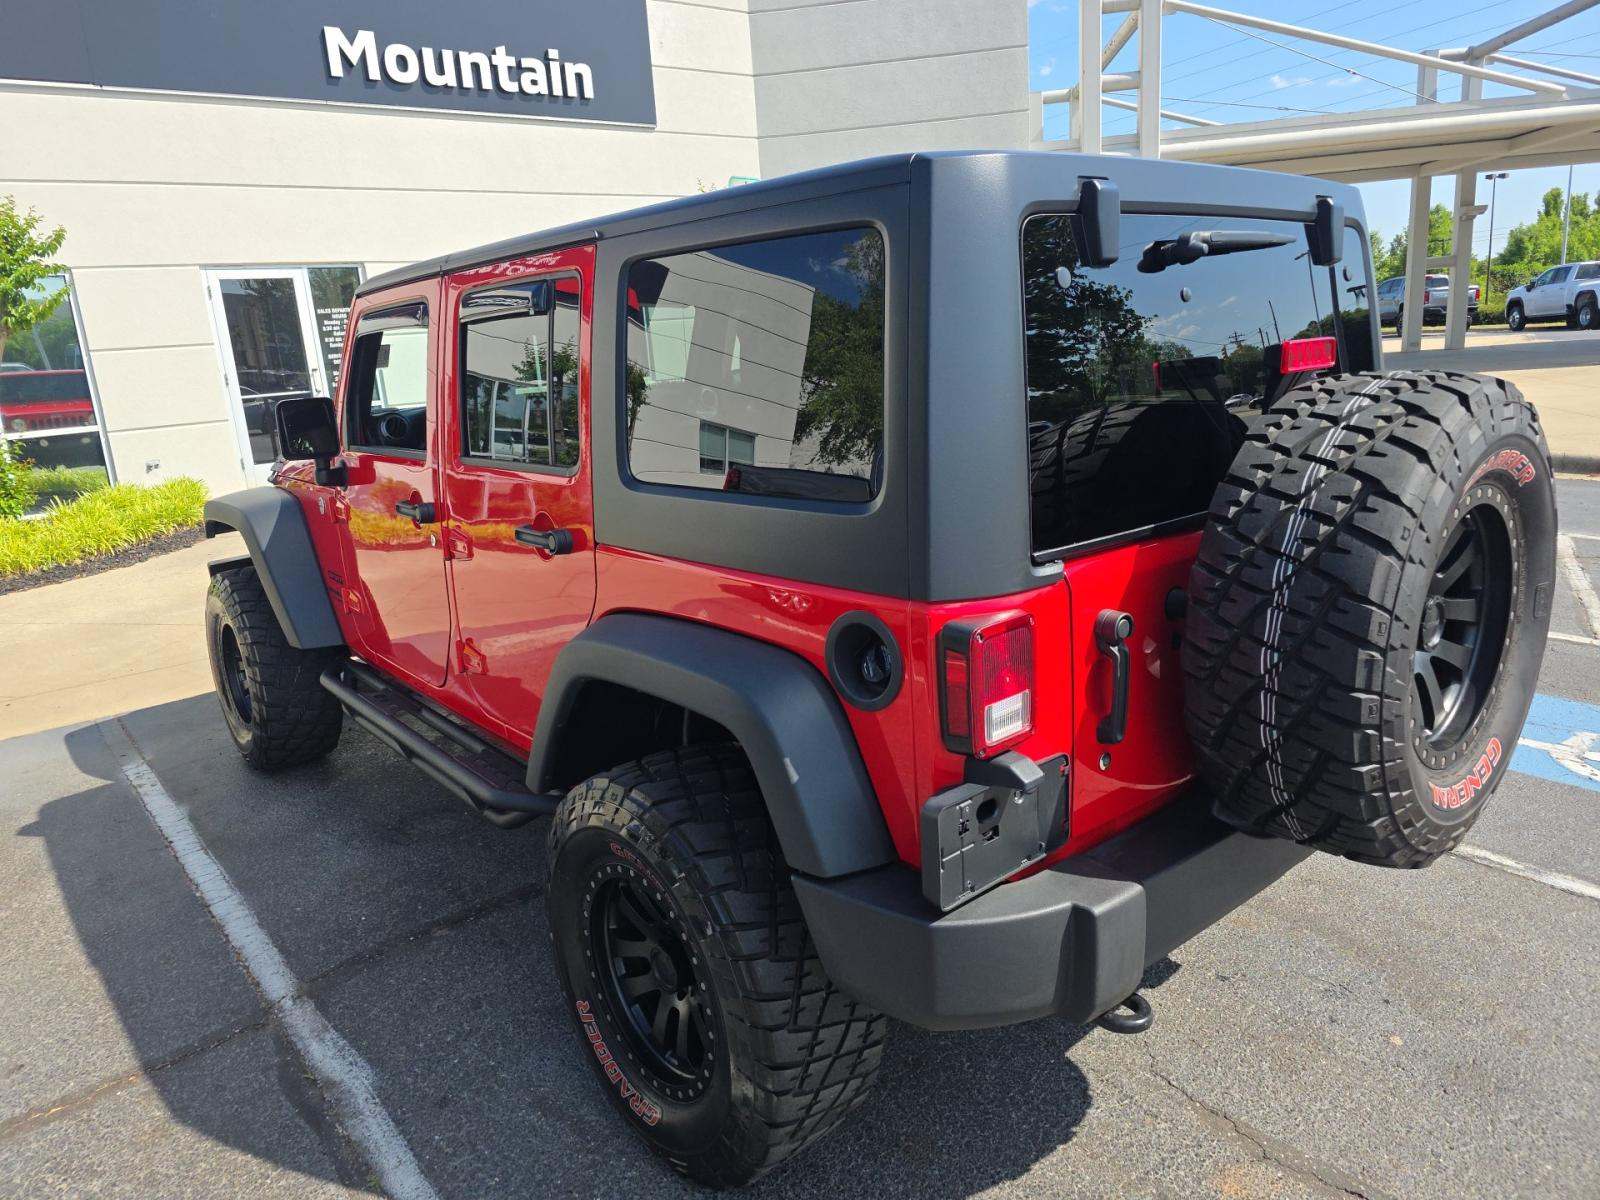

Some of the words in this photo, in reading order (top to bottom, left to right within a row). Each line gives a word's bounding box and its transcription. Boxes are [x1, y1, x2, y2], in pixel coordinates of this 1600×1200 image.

[323, 25, 594, 99] Mountain
[1428, 738, 1502, 809] GENERAL
[576, 1001, 661, 1126] GRABBER
